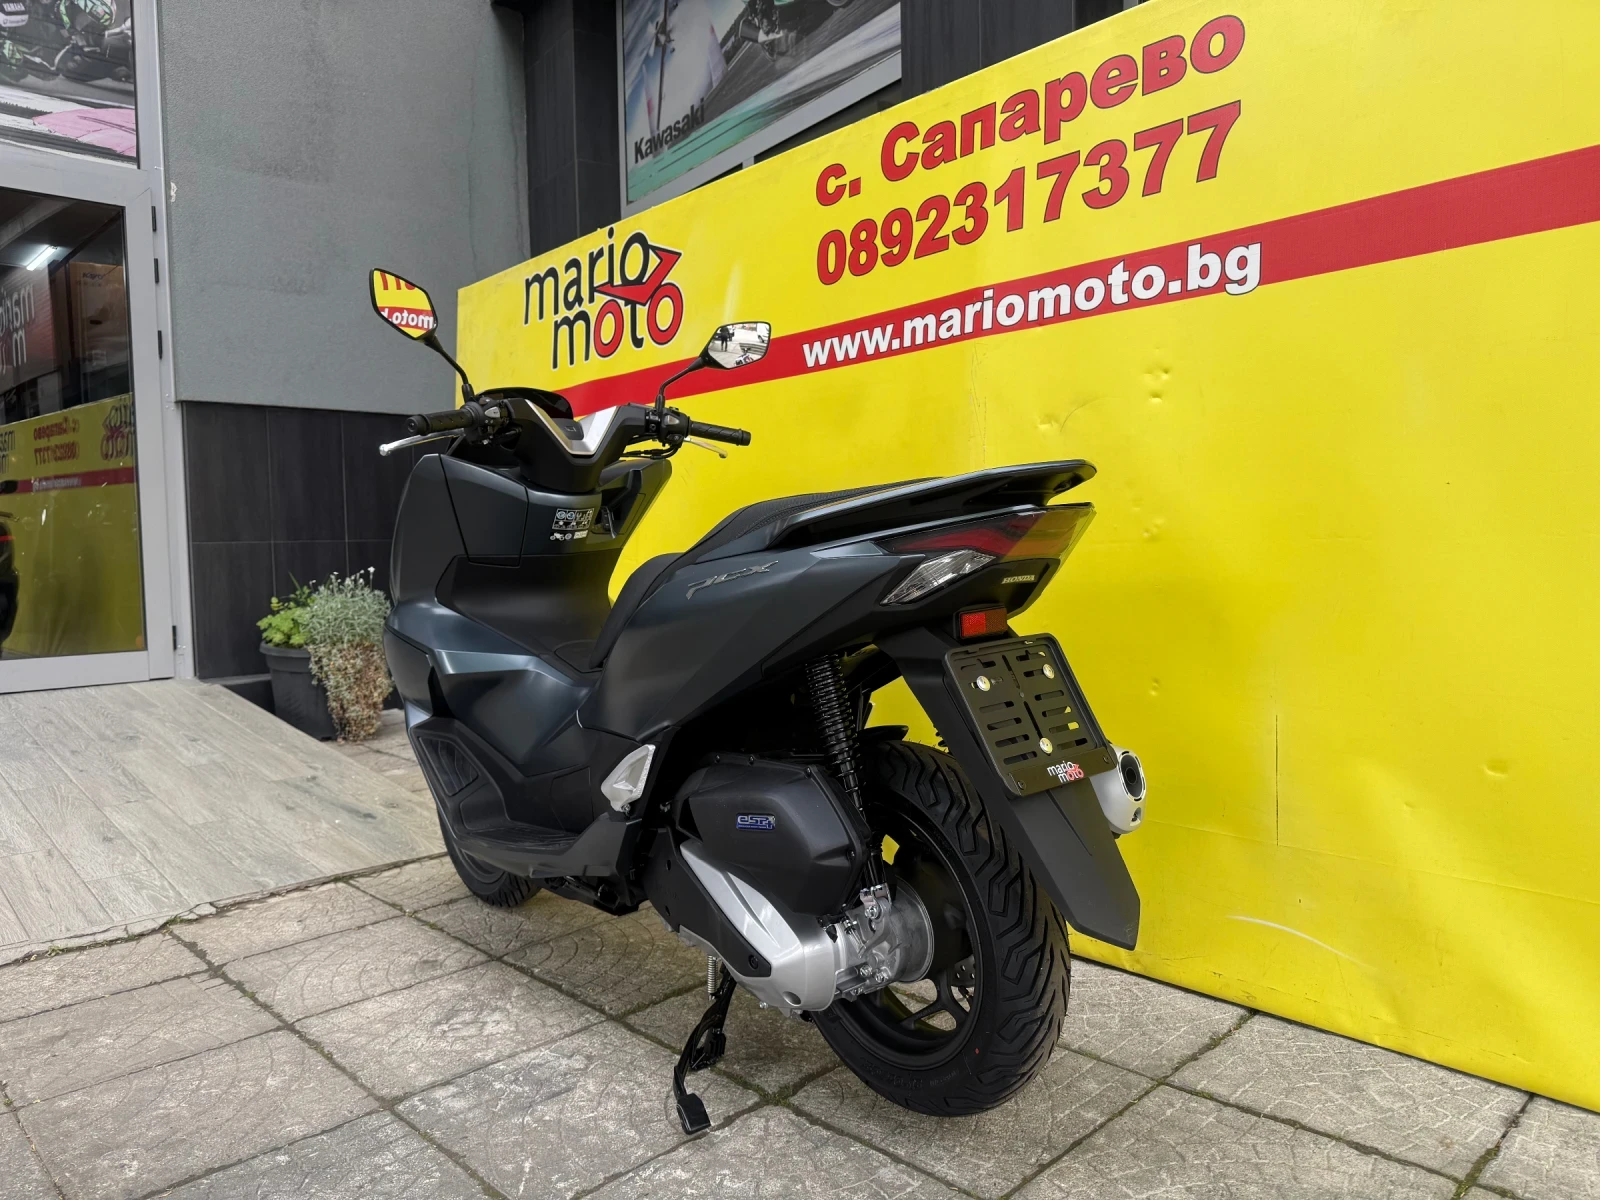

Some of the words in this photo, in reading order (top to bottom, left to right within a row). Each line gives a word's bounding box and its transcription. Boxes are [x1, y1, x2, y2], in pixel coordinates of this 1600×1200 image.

[633, 97, 706, 165] Kawasaki
[814, 164, 863, 207] с.
[879, 15, 1247, 183] Сапарево
[816, 101, 1242, 286] 0892317377
[524, 226, 651, 325] mario
[802, 242, 1263, 368] www.mariomoto.bg
[552, 282, 684, 370] moto
[685, 560, 779, 600] PCX
[1001, 574, 1036, 584] HONDA
[1046, 760, 1074, 777] mario
[1057, 769, 1085, 784] moto
